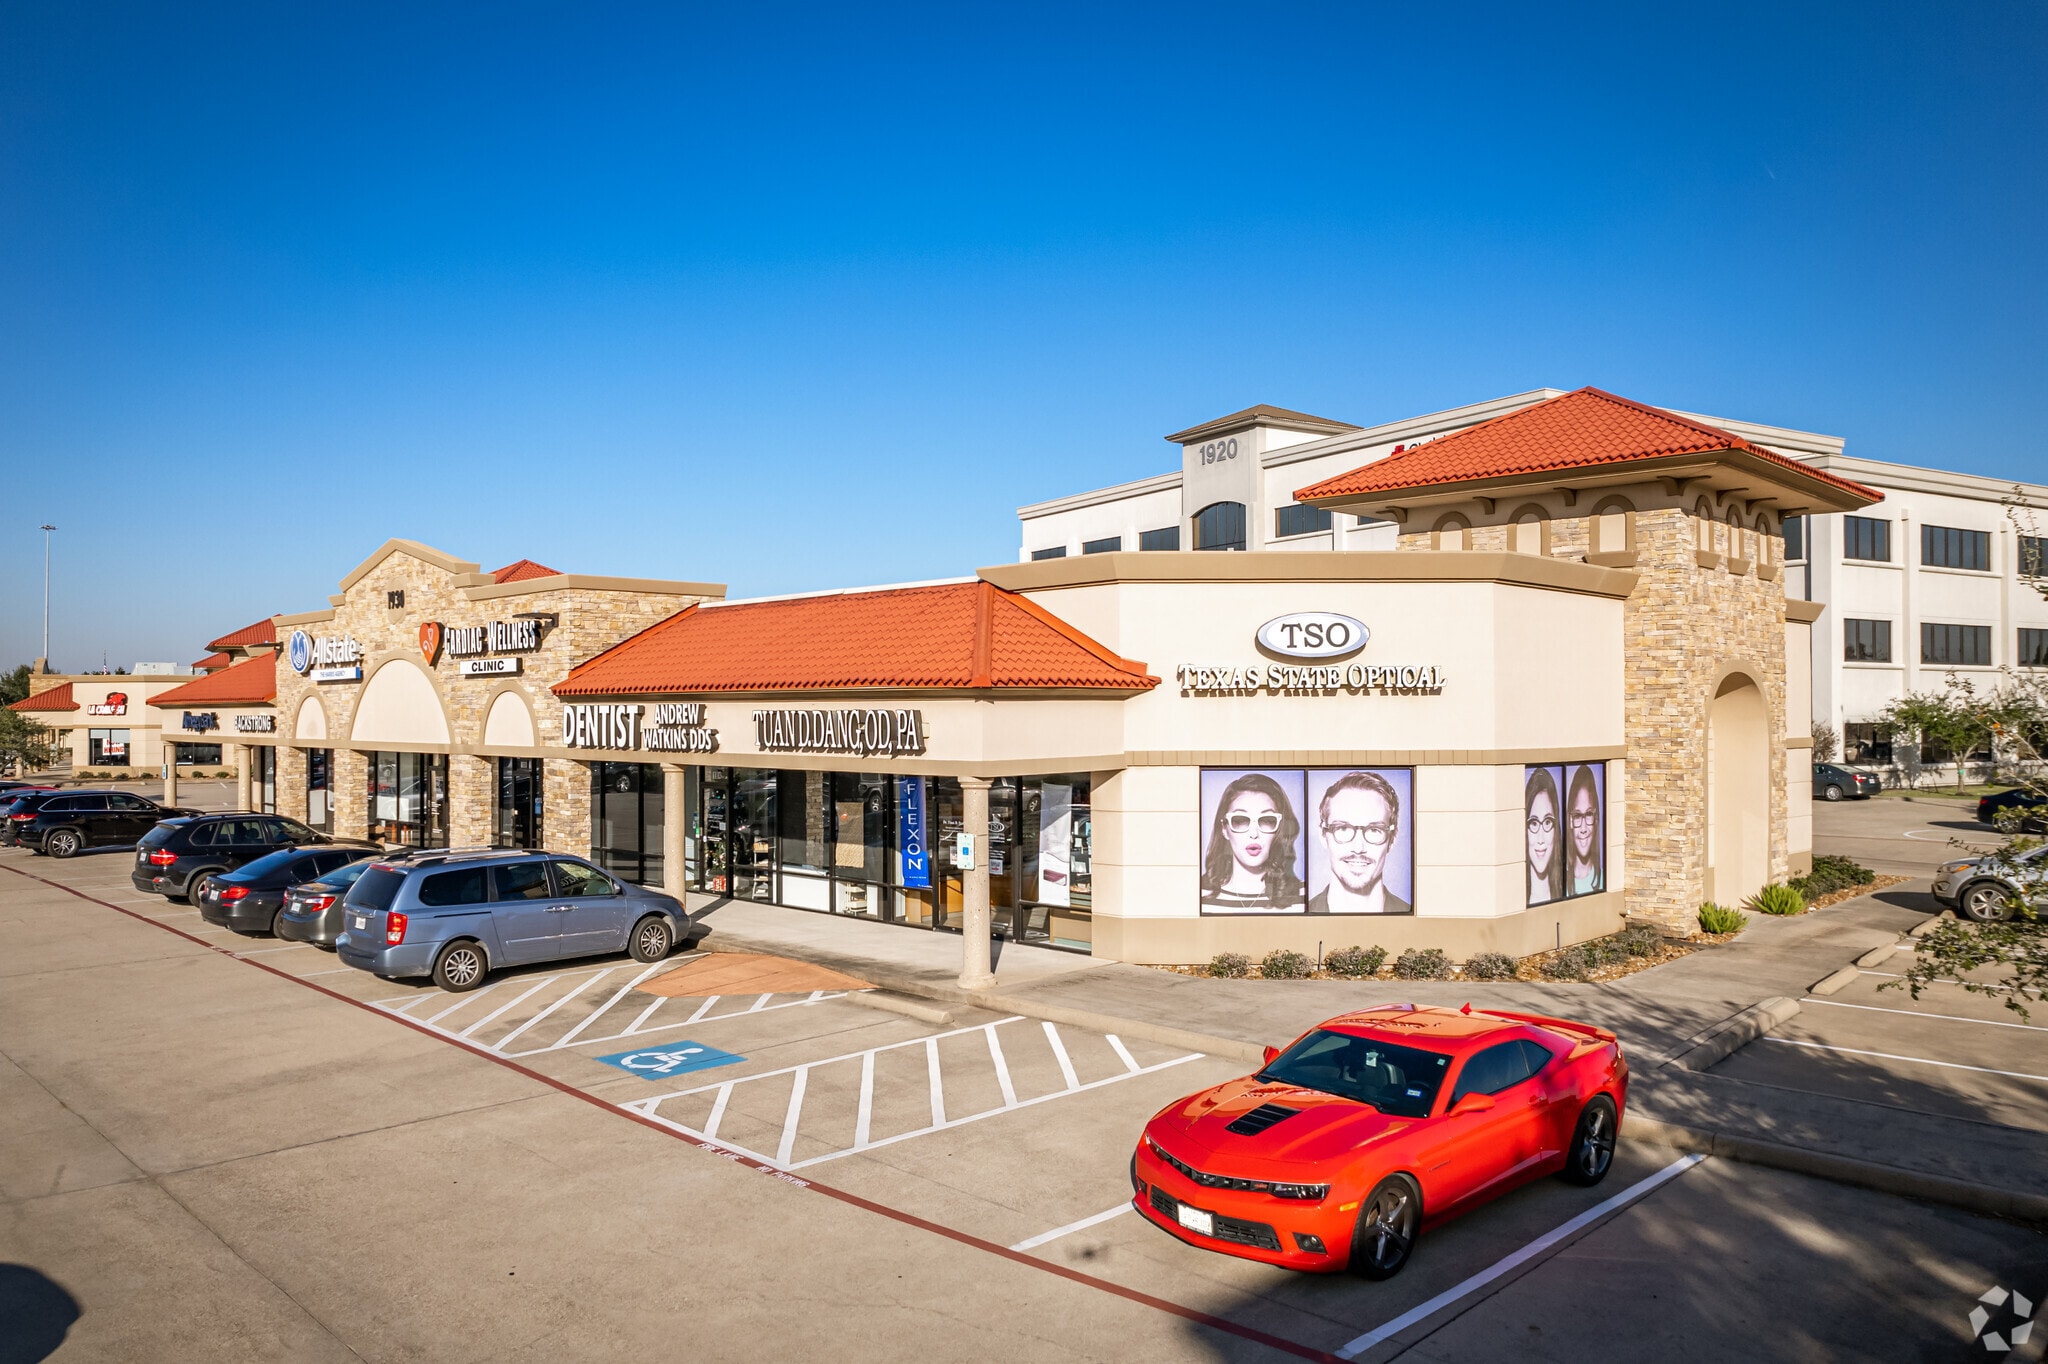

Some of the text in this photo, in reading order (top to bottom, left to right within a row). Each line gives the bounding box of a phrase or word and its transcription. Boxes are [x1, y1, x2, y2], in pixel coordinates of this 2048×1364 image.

[1199, 438, 1238, 466] 1920
[387, 589, 405, 610] 1930
[444, 620, 536, 655] CARDIAC WELLNESS
[1280, 622, 1350, 649] TSO
[311, 634, 357, 665] Allstate
[471, 660, 505, 672] CLINIC
[1177, 663, 1448, 690] TEXAS STATE OPTICAL
[563, 704, 639, 748] DENTIST
[654, 703, 700, 725] ANDREW
[642, 728, 712, 750] WATKINS DDS
[752, 709, 795, 747] TUAN
[896, 709, 920, 750] PA
[907, 783, 923, 871] FLEXON
[697, 1143, 744, 1161] FIRE LANE
[756, 1165, 811, 1188] NO PARKING
